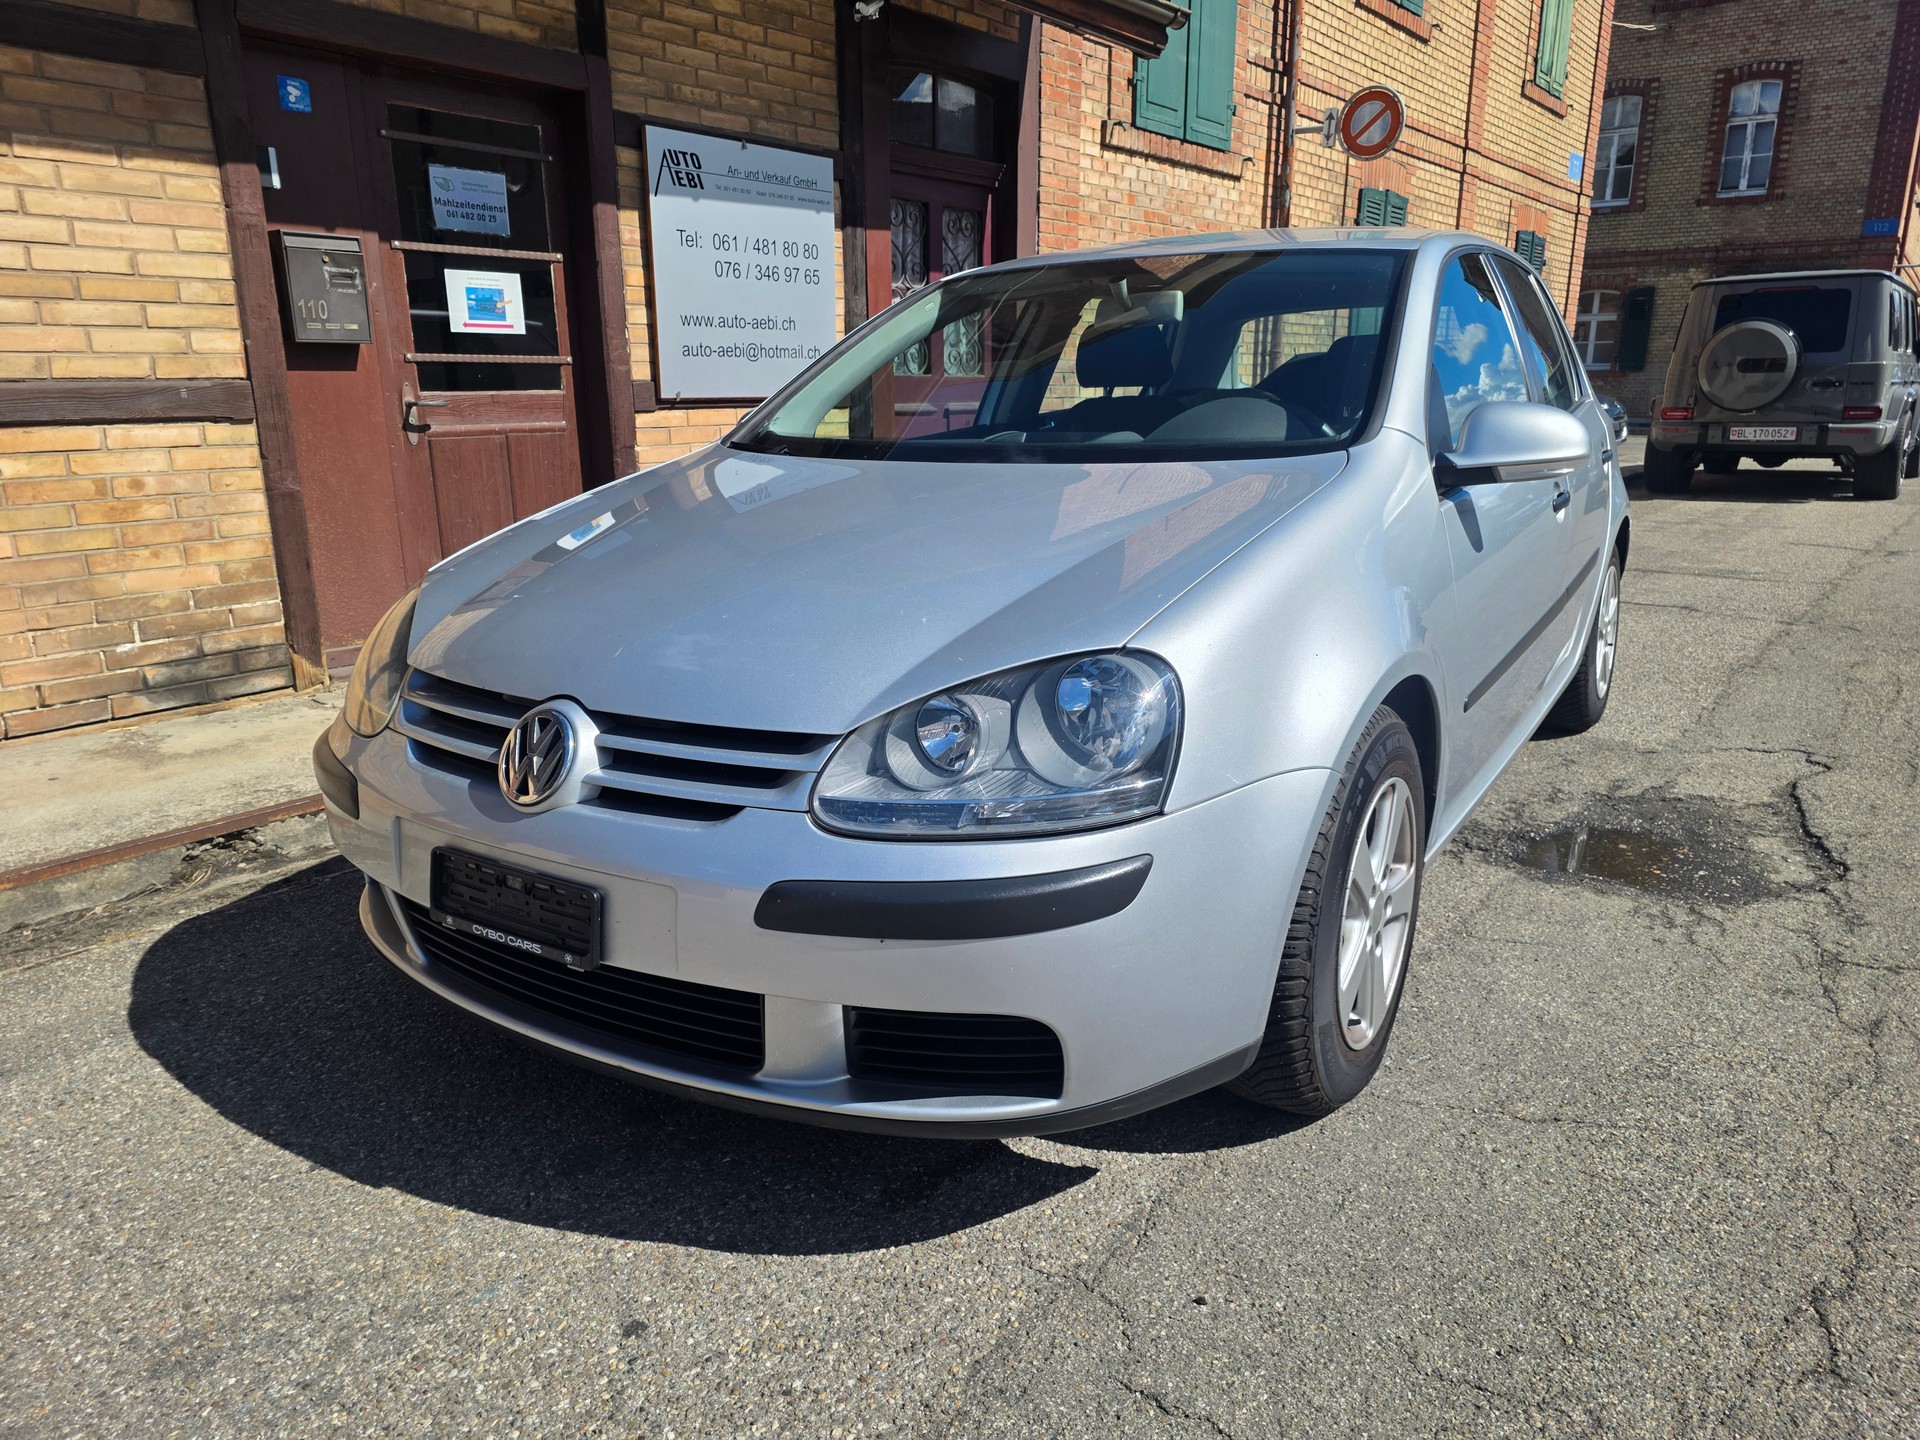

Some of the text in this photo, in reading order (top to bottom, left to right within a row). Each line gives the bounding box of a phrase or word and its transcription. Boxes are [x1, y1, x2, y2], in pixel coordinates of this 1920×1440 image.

[655, 148, 703, 197] AUTO
[727, 165, 818, 189] An- und Verkauf GmbH
[434, 197, 507, 214] Mahlzeitendienst
[446, 210, 497, 223] 061 482 00 25
[676, 229, 819, 260] Tel: 061 / 481 80 80
[714, 261, 820, 285] 076 / 346 97 65
[298, 298, 328, 320] 110
[680, 314, 796, 331] www.auto-aebi.ch
[682, 343, 821, 362] auto-aebi@hotmail.ch
[472, 924, 542, 954] CYBO CARS
